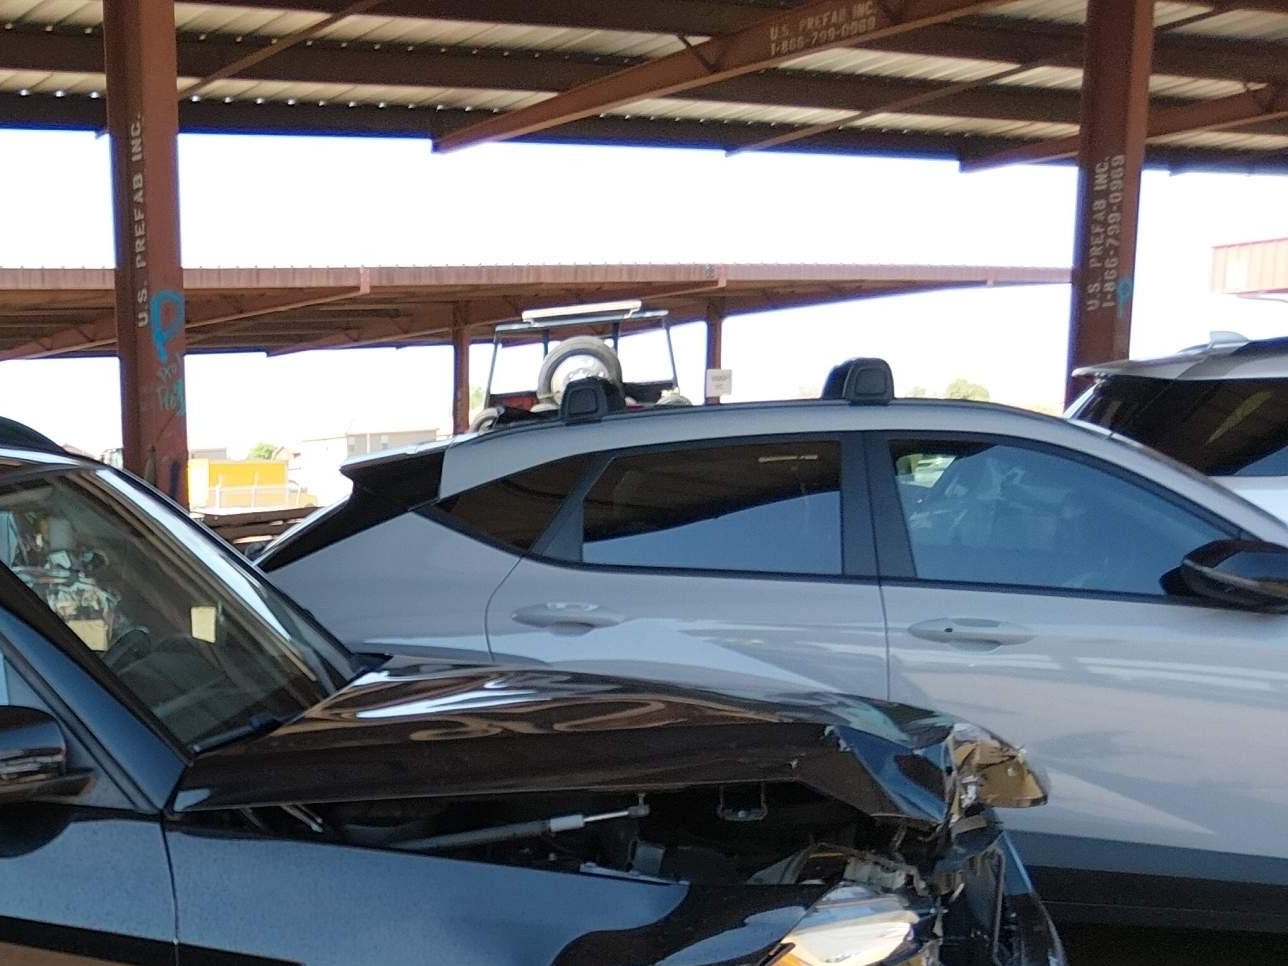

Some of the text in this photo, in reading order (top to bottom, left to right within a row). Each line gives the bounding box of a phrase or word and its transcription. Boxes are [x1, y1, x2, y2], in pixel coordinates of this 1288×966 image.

[130, 112, 150, 328] U.S. PREFAB INC.
[1087, 156, 1110, 311] U.S. PREFAB INC.
